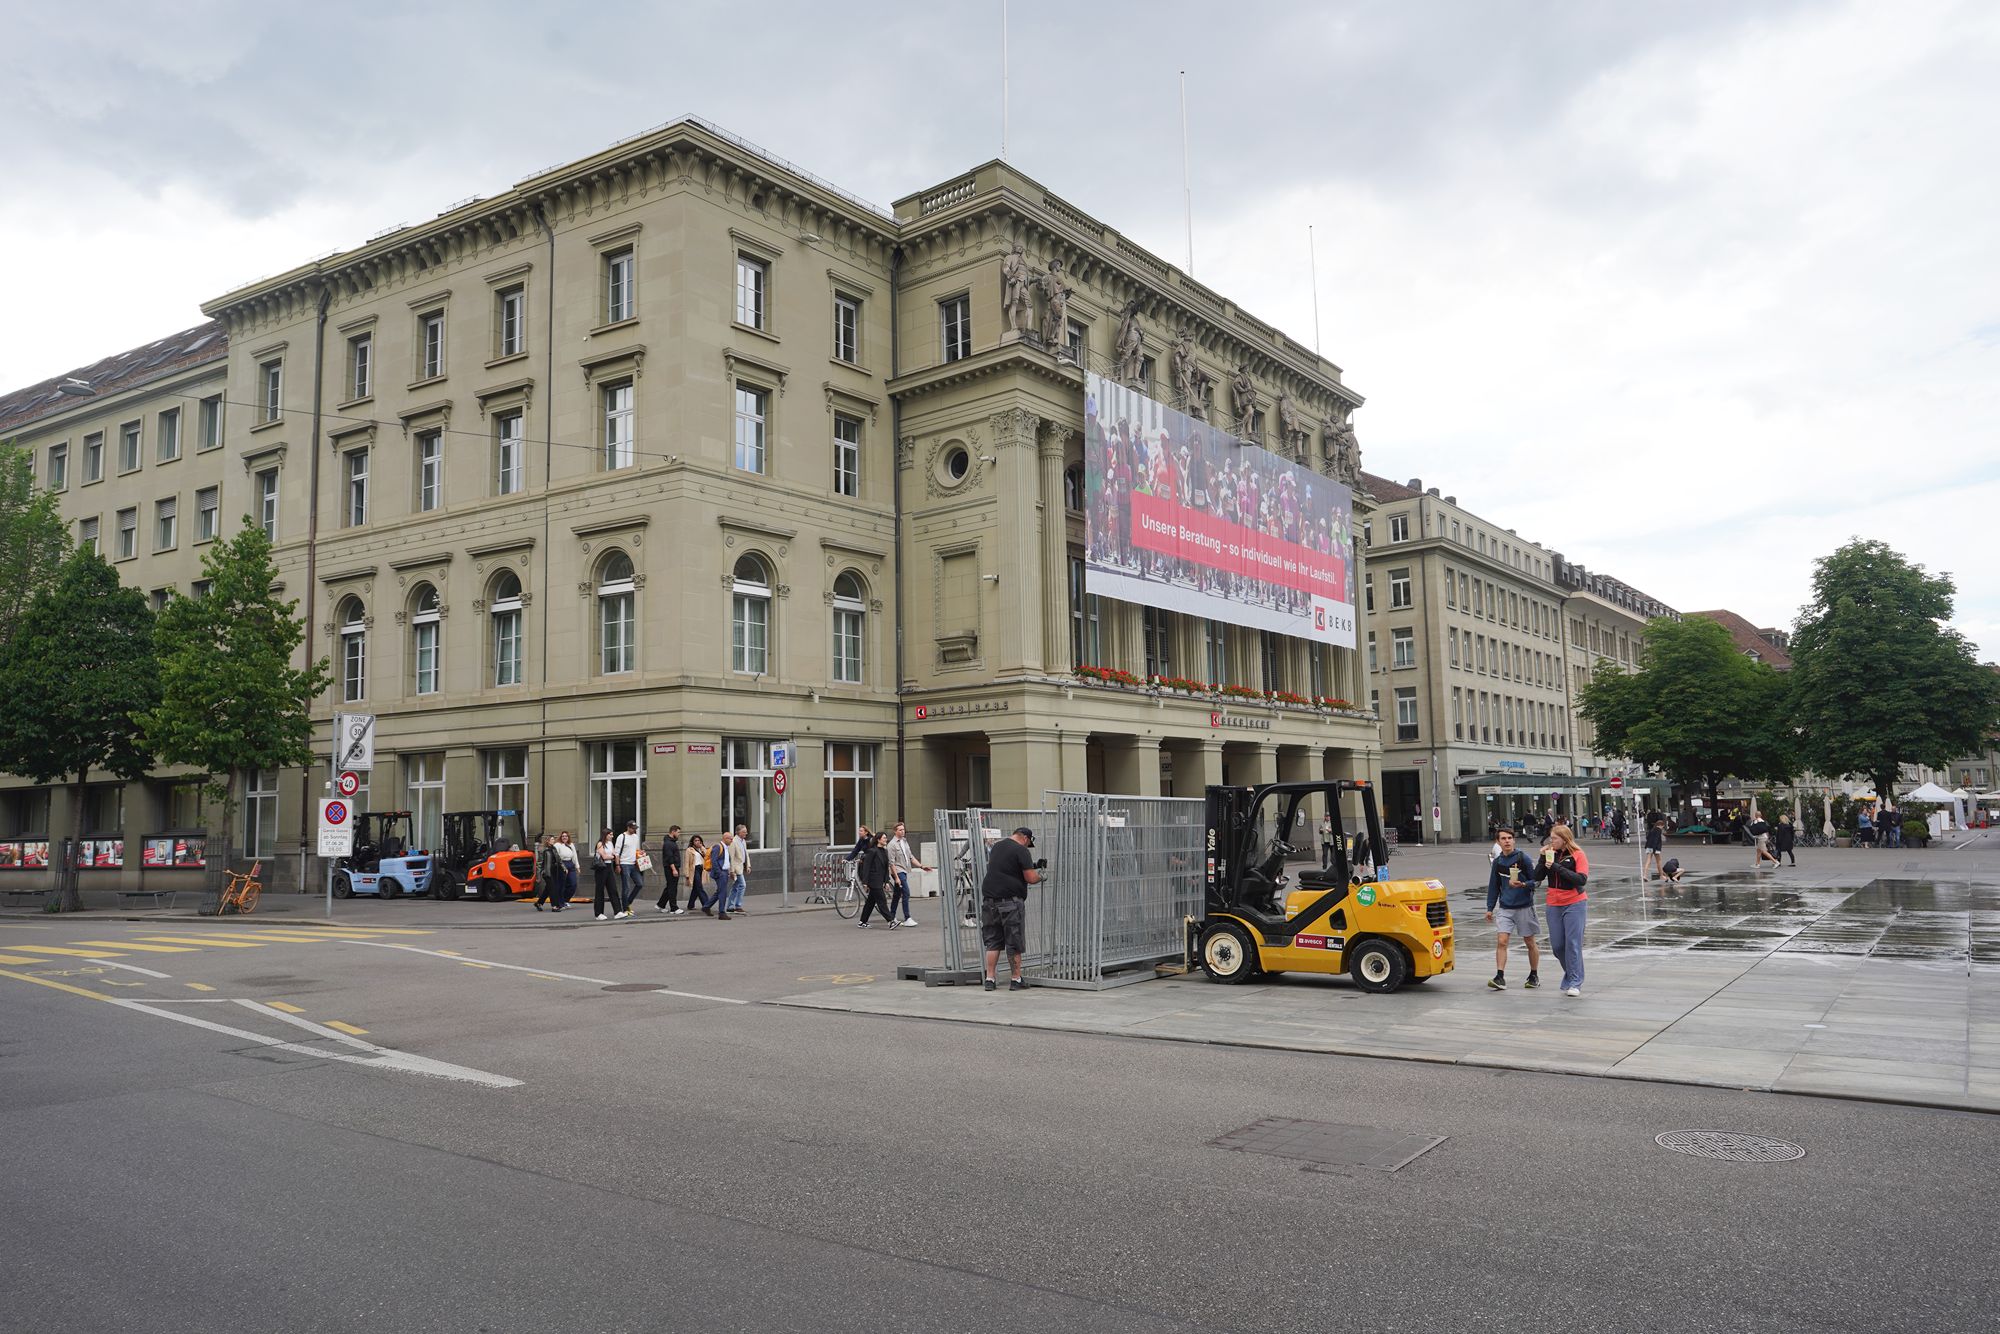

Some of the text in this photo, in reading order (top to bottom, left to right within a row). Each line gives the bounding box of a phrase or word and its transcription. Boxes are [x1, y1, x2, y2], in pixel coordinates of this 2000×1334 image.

[1141, 513, 1176, 537] Unsere
[1179, 525, 1221, 554] Beratung
[1229, 543, 1239, 556] so
[1241, 544, 1282, 568] individuell
[1283, 559, 1297, 573] wie
[1298, 562, 1309, 576] Ihr
[1310, 565, 1337, 584] Laufstil.
[1329, 615, 1352, 632] BEKB
[354, 728, 363, 736] 30
[344, 780, 354, 789] 40
[1207, 828, 1216, 852] Yale
